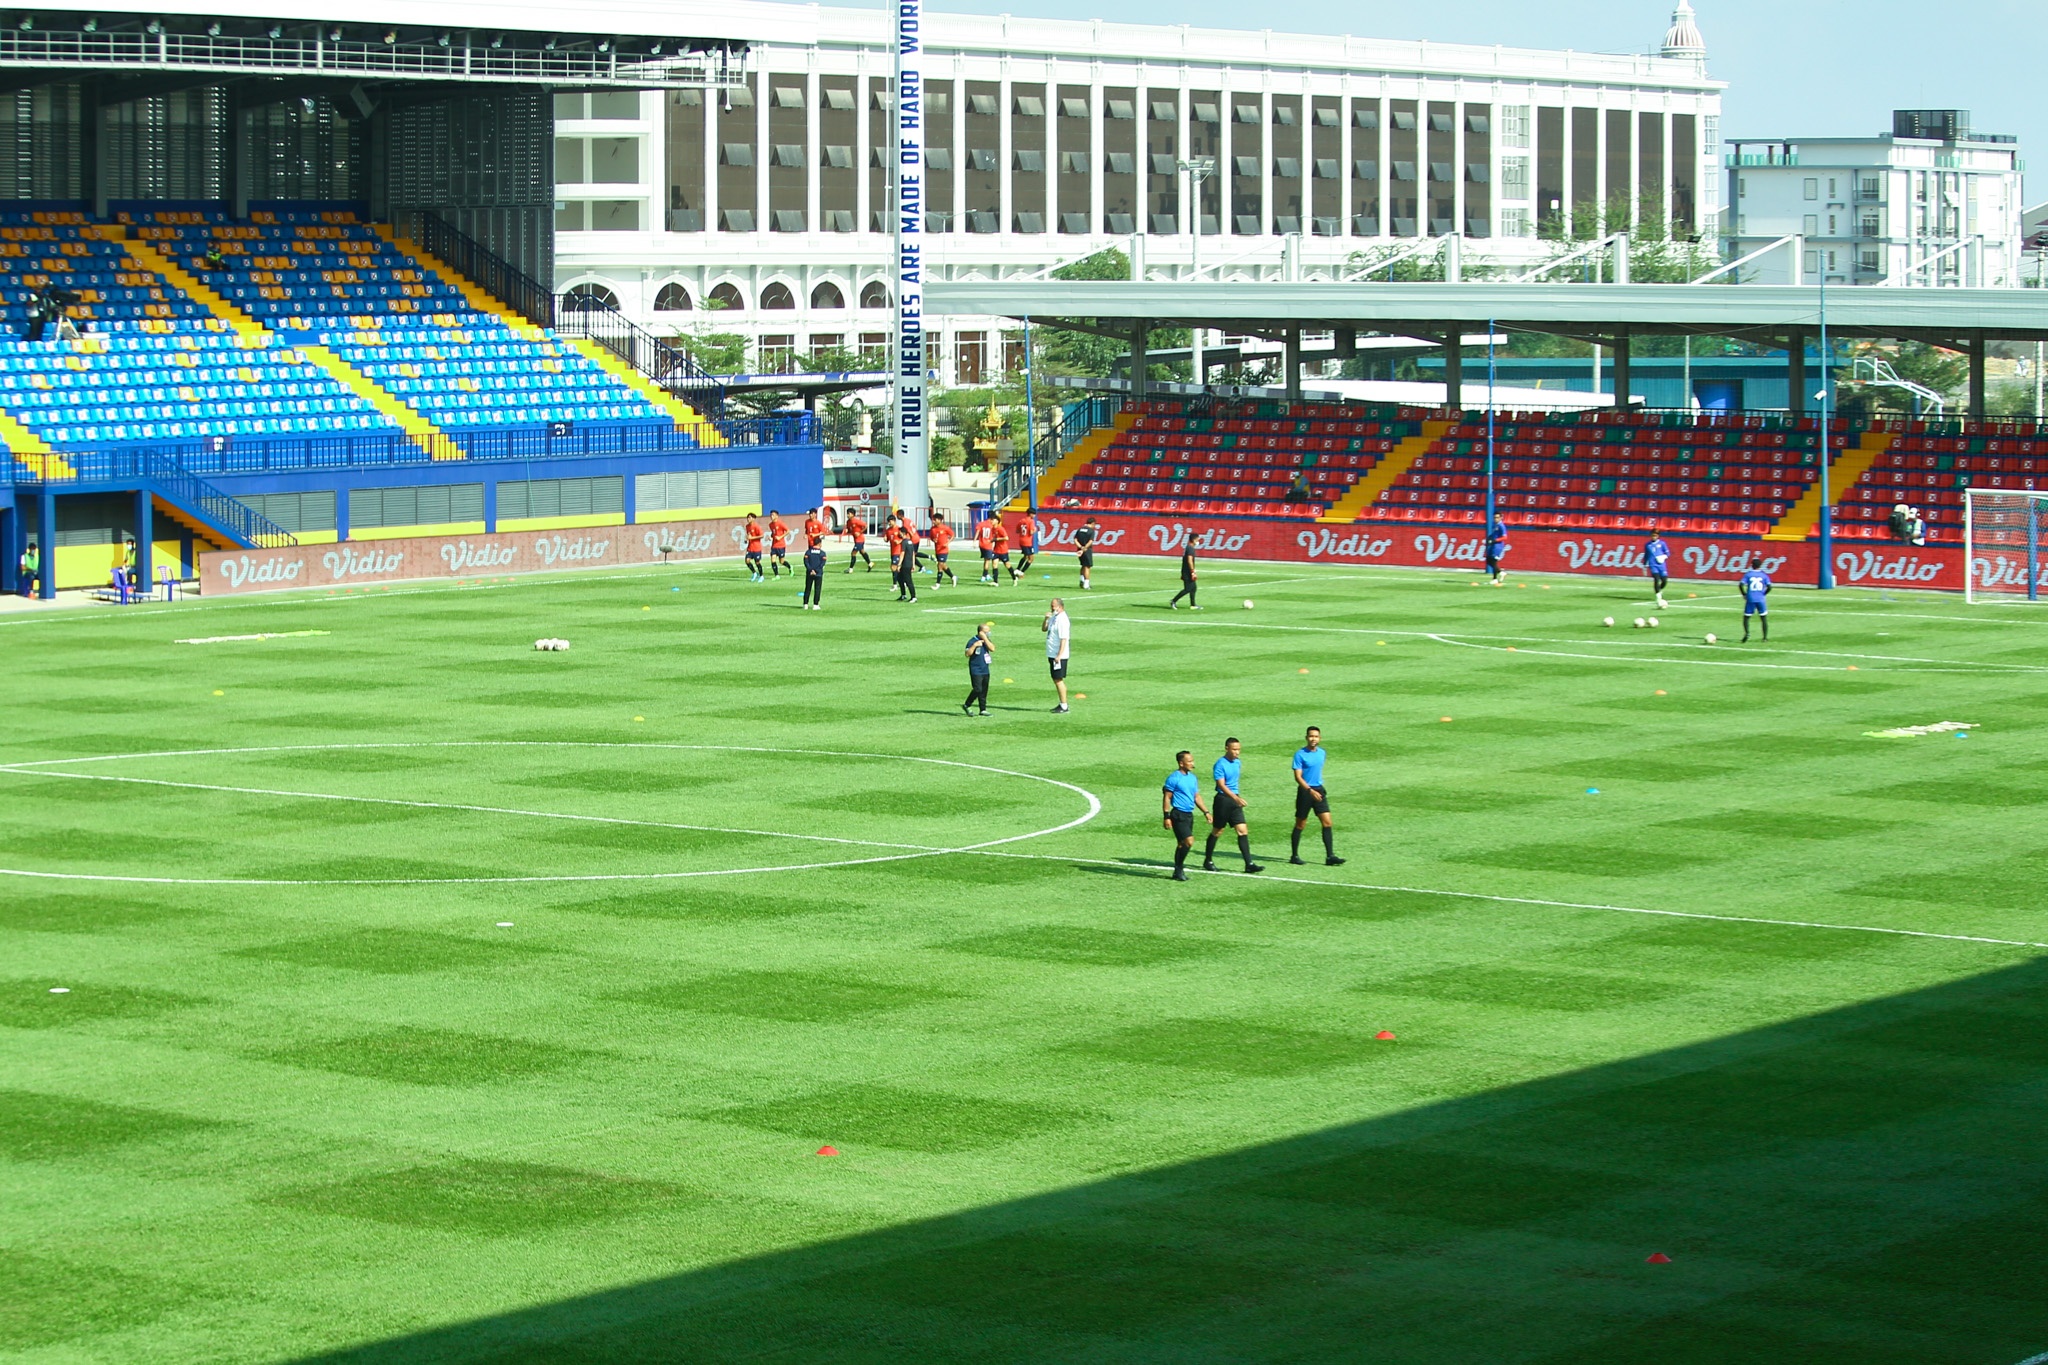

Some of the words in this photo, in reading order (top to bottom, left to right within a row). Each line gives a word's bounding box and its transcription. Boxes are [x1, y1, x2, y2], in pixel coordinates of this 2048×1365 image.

[900, 0, 919, 54] WOR
[901, 70, 920, 128] HARD
[901, 139, 920, 164] OF
[901, 174, 920, 233] MADE
[902, 243, 920, 283] ARE
[902, 294, 921, 376] HEROES
[535, 536, 609, 564] Vidio
[644, 528, 716, 556] Vidio
[1149, 523, 1251, 551] Vidio
[1298, 529, 1392, 557] Vidio
[323, 548, 404, 579] Vidio
[441, 540, 518, 571] Vidio
[1837, 550, 1944, 581] Vidio
[221, 555, 303, 588] Vidio
[1749, 577, 1763, 591] 26
